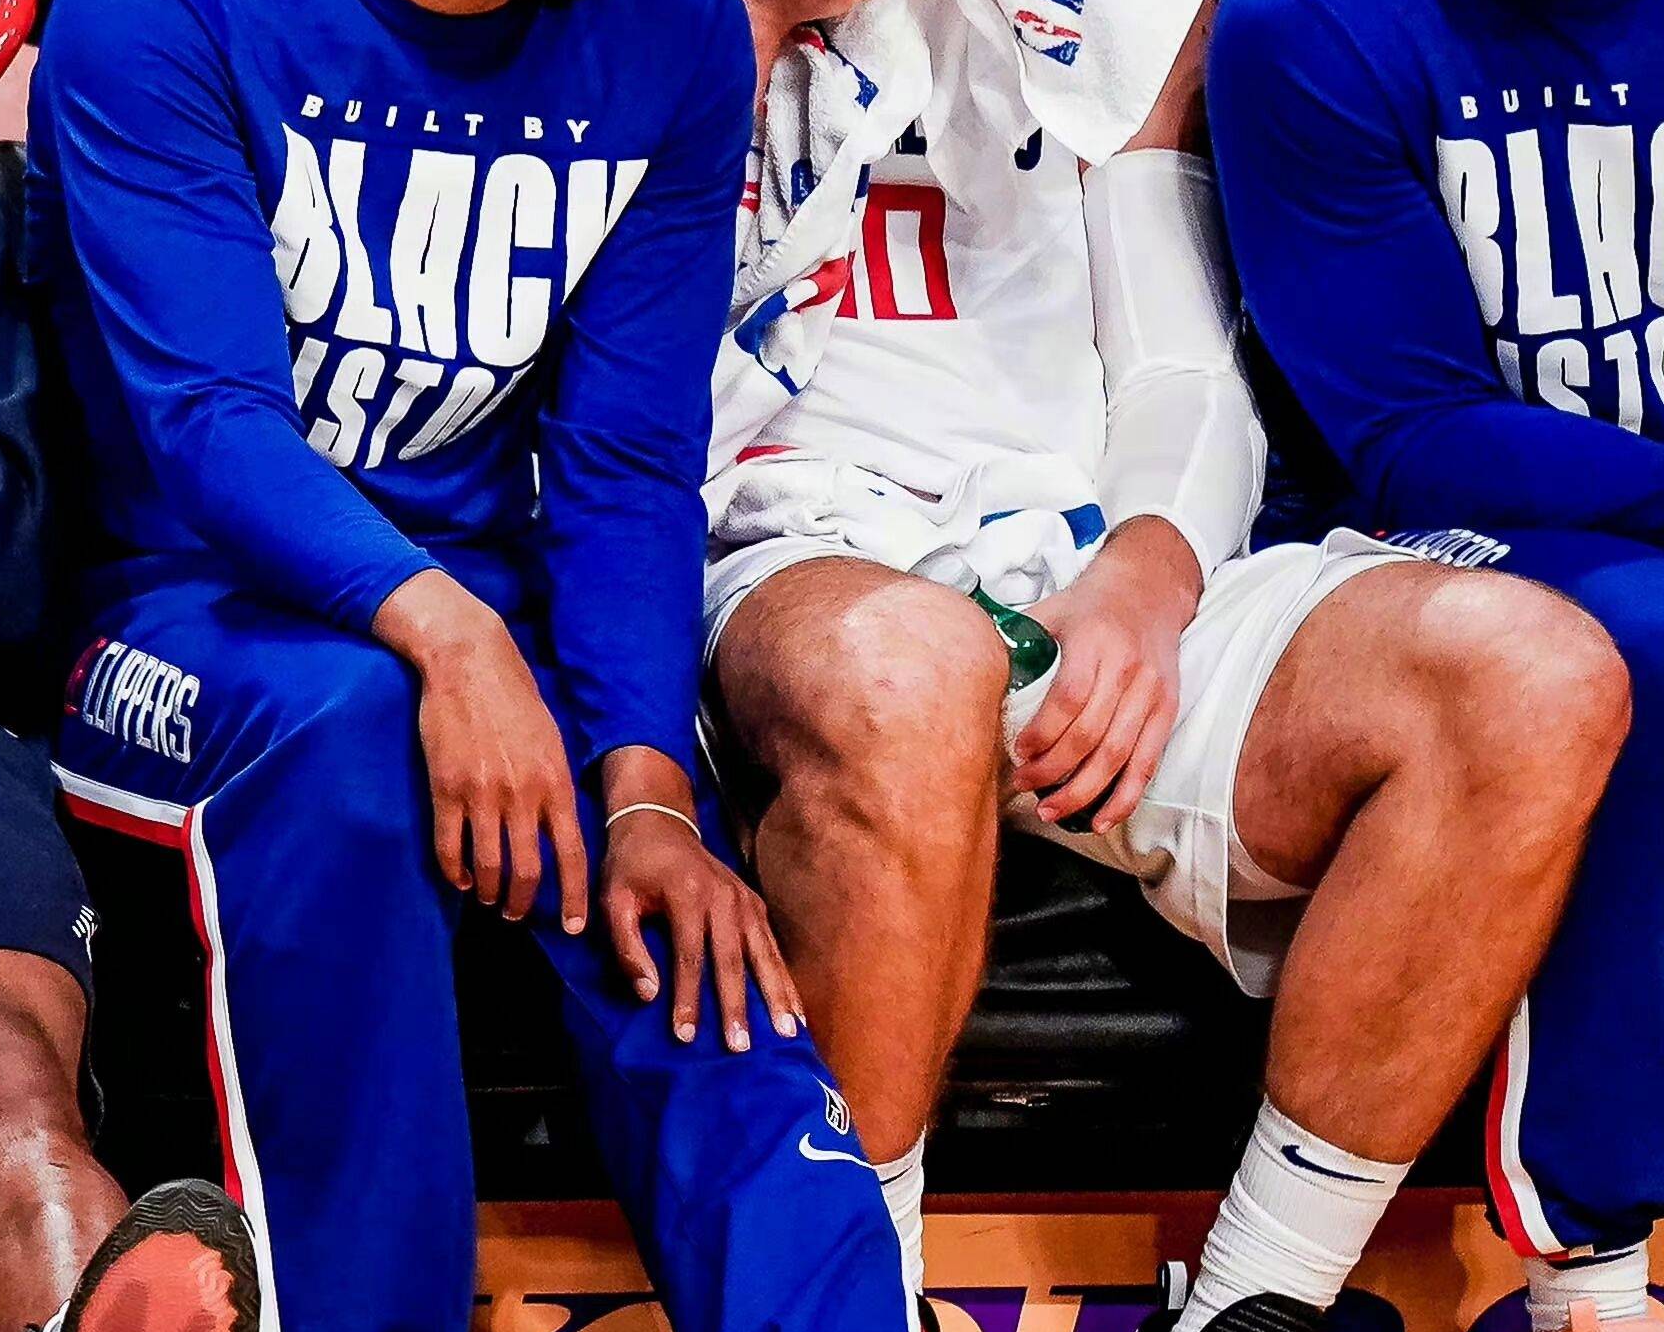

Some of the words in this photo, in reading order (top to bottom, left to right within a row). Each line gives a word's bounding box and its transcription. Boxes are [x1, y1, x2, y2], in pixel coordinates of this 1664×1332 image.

[300, 93, 485, 139] BUILT
[524, 115, 591, 145] BY
[1461, 82, 1629, 120] BUILT
[1437, 124, 1664, 335] BLA
[82, 641, 201, 764] CLIPPERS
